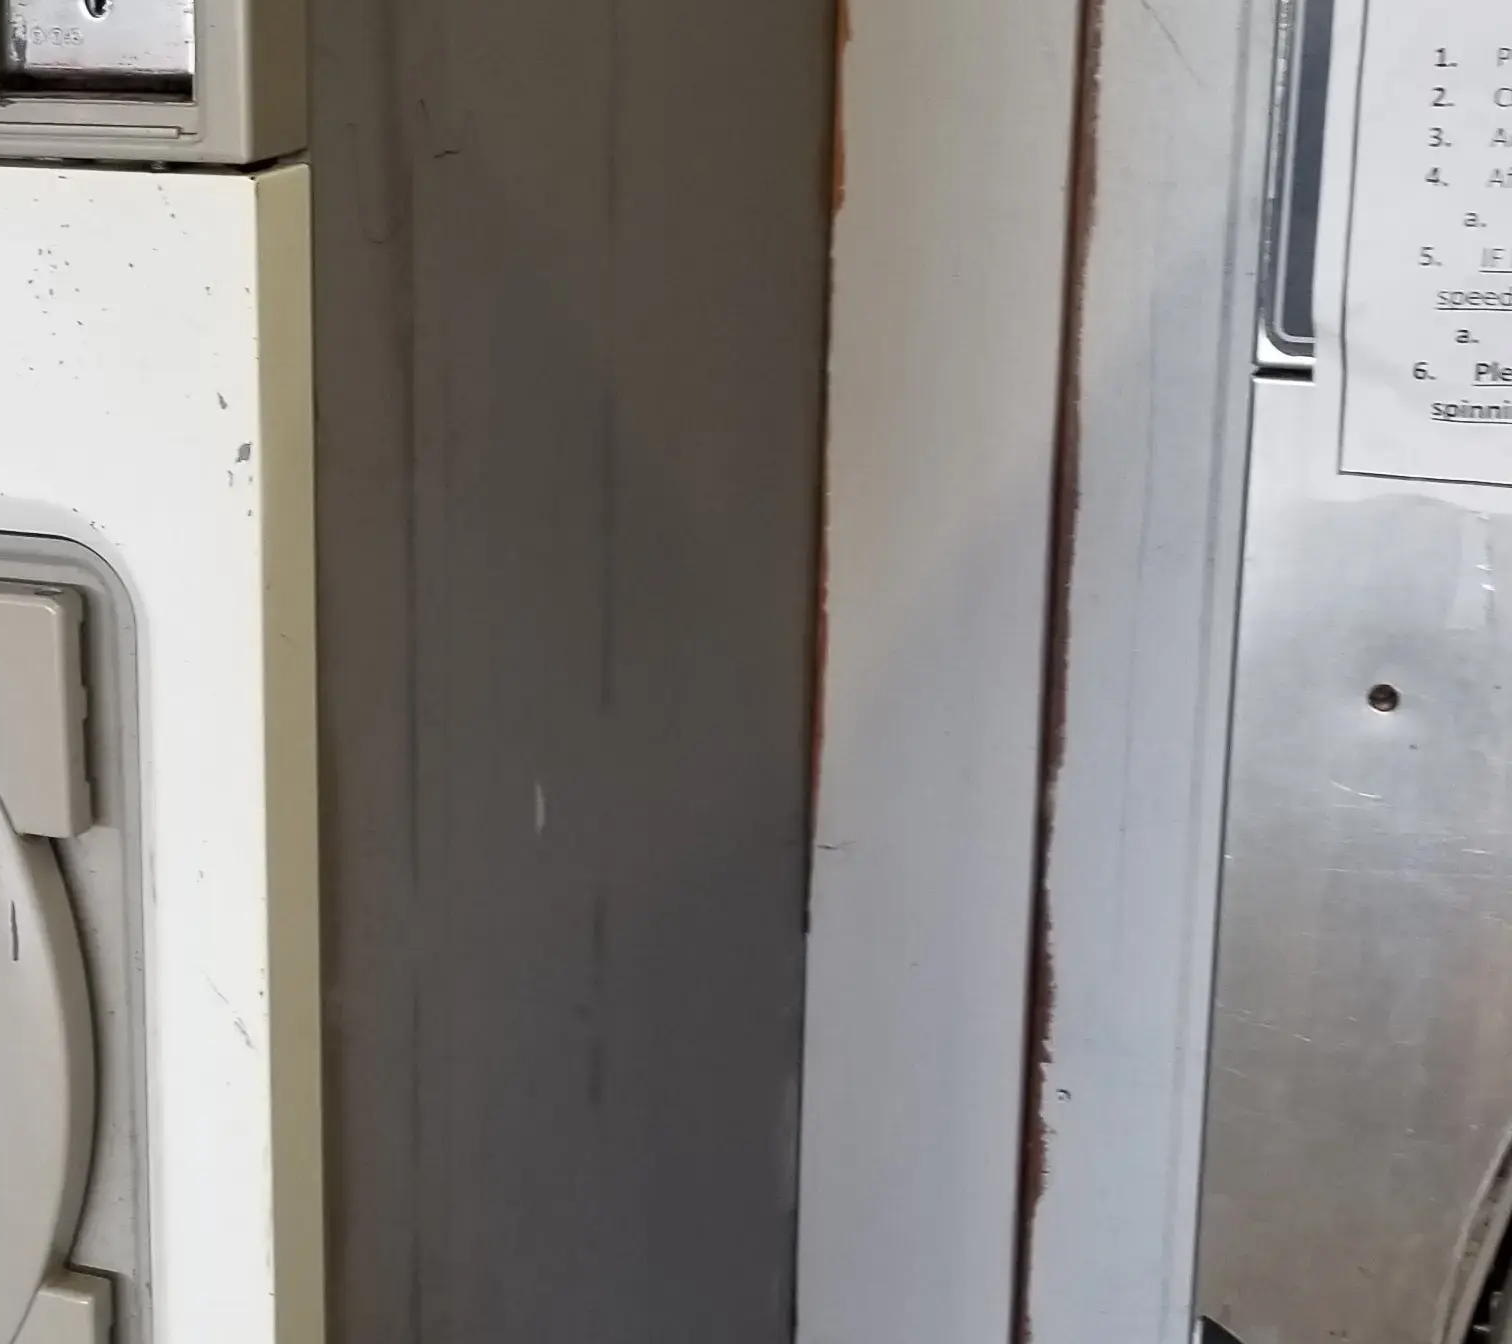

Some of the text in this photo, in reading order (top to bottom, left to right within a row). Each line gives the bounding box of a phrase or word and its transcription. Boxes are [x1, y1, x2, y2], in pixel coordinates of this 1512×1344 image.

[1434, 48, 1458, 67] 1.
[1430, 87, 1455, 107] 2.
[1428, 127, 1452, 147] 3.
[1424, 166, 1450, 187] 4.
[1463, 212, 1487, 228] a.
[1418, 246, 1443, 266] 5.
[1454, 328, 1480, 344] a.
[1412, 362, 1437, 380] 6.
